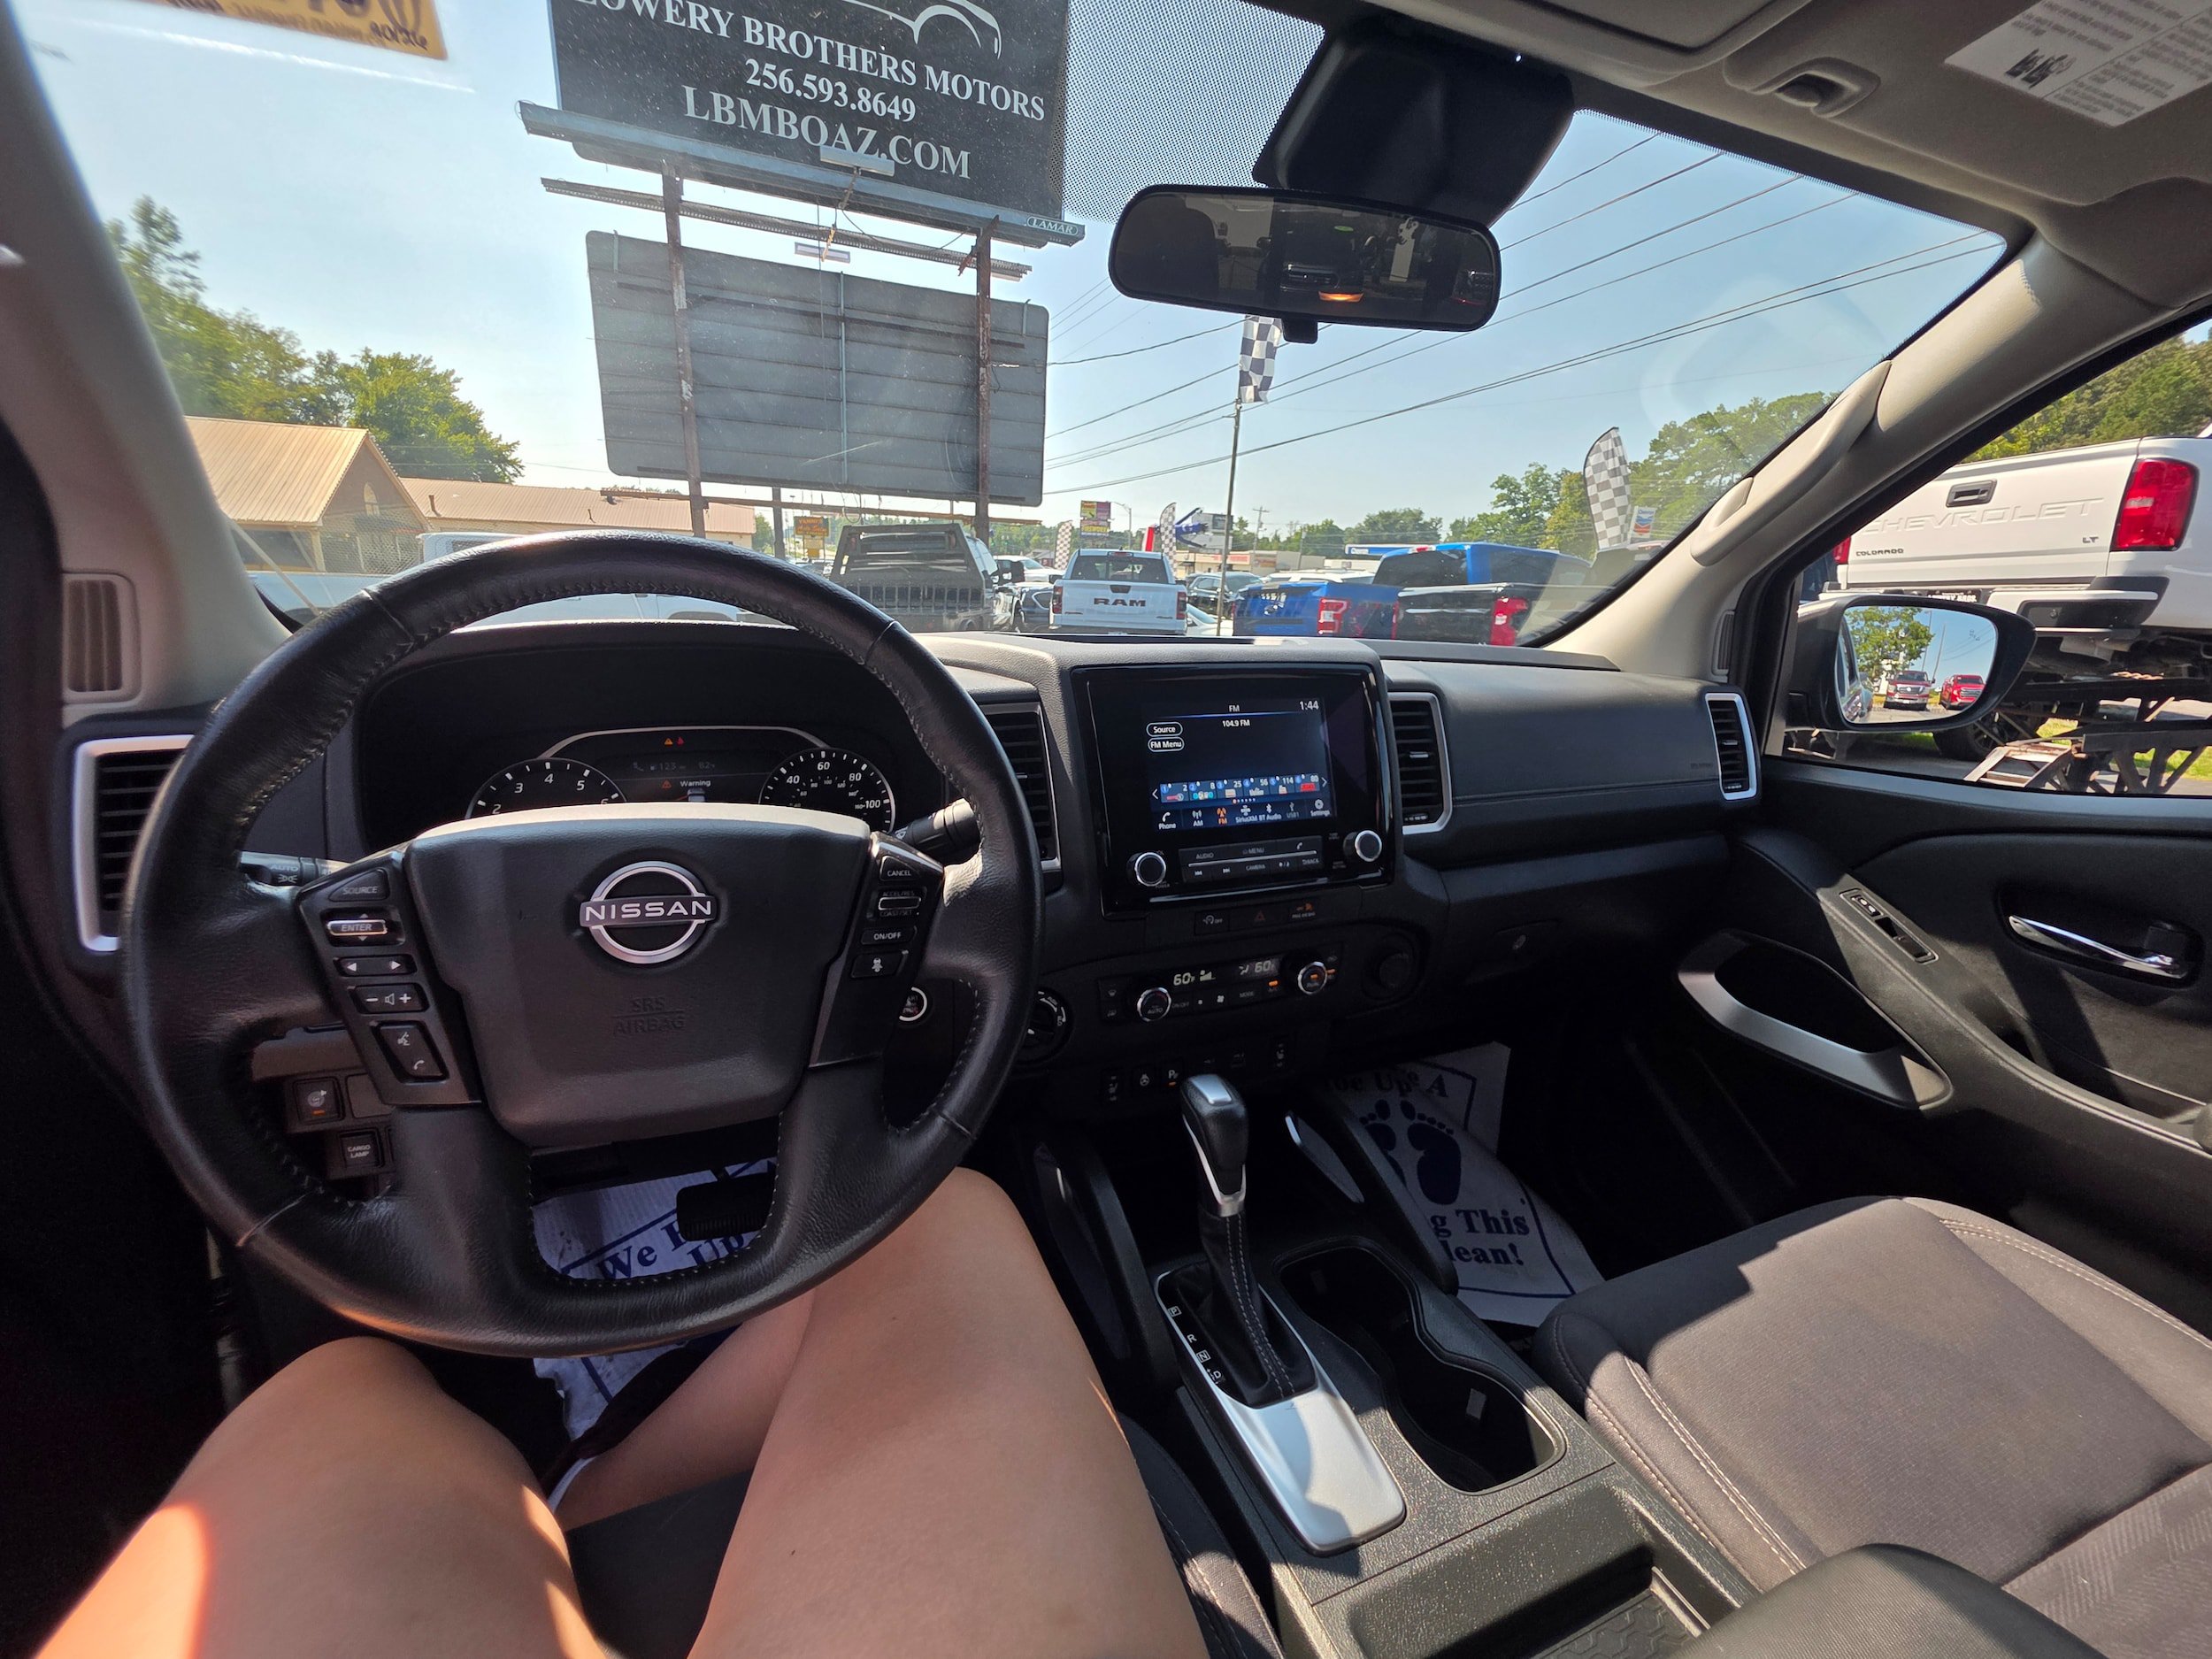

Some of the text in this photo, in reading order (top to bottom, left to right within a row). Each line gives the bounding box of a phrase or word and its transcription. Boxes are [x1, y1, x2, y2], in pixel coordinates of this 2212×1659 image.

[575, 0, 1045, 121] WERY BROTHERS MOTORS
[745, 58, 917, 122] 256.593.8649
[684, 85, 971, 179] LBMBOAZ.COM
[1033, 219, 1073, 234] LAMAR
[1855, 548, 1904, 557] COLORADO
[1094, 598, 1146, 607] RAM
[1300, 701, 1319, 710] 1:44
[817, 761, 831, 771] 60
[544, 772, 554, 784] 4
[786, 774, 800, 784] 40
[849, 772, 862, 782] 80
[514, 782, 524, 794] 3
[576, 780, 585, 791] 5
[680, 779, 711, 787] Warning
[492, 803, 502, 814] 2
[864, 799, 881, 809] 100
[342, 886, 378, 895] SOURCE
[585, 901, 711, 921] NISSAN
[873, 932, 902, 941] ON/OFF
[1455, 1209, 1530, 1236] This
[1439, 1240, 1525, 1265] lean!
[596, 1244, 657, 1279] We
[1187, 1333, 1197, 1343] R
